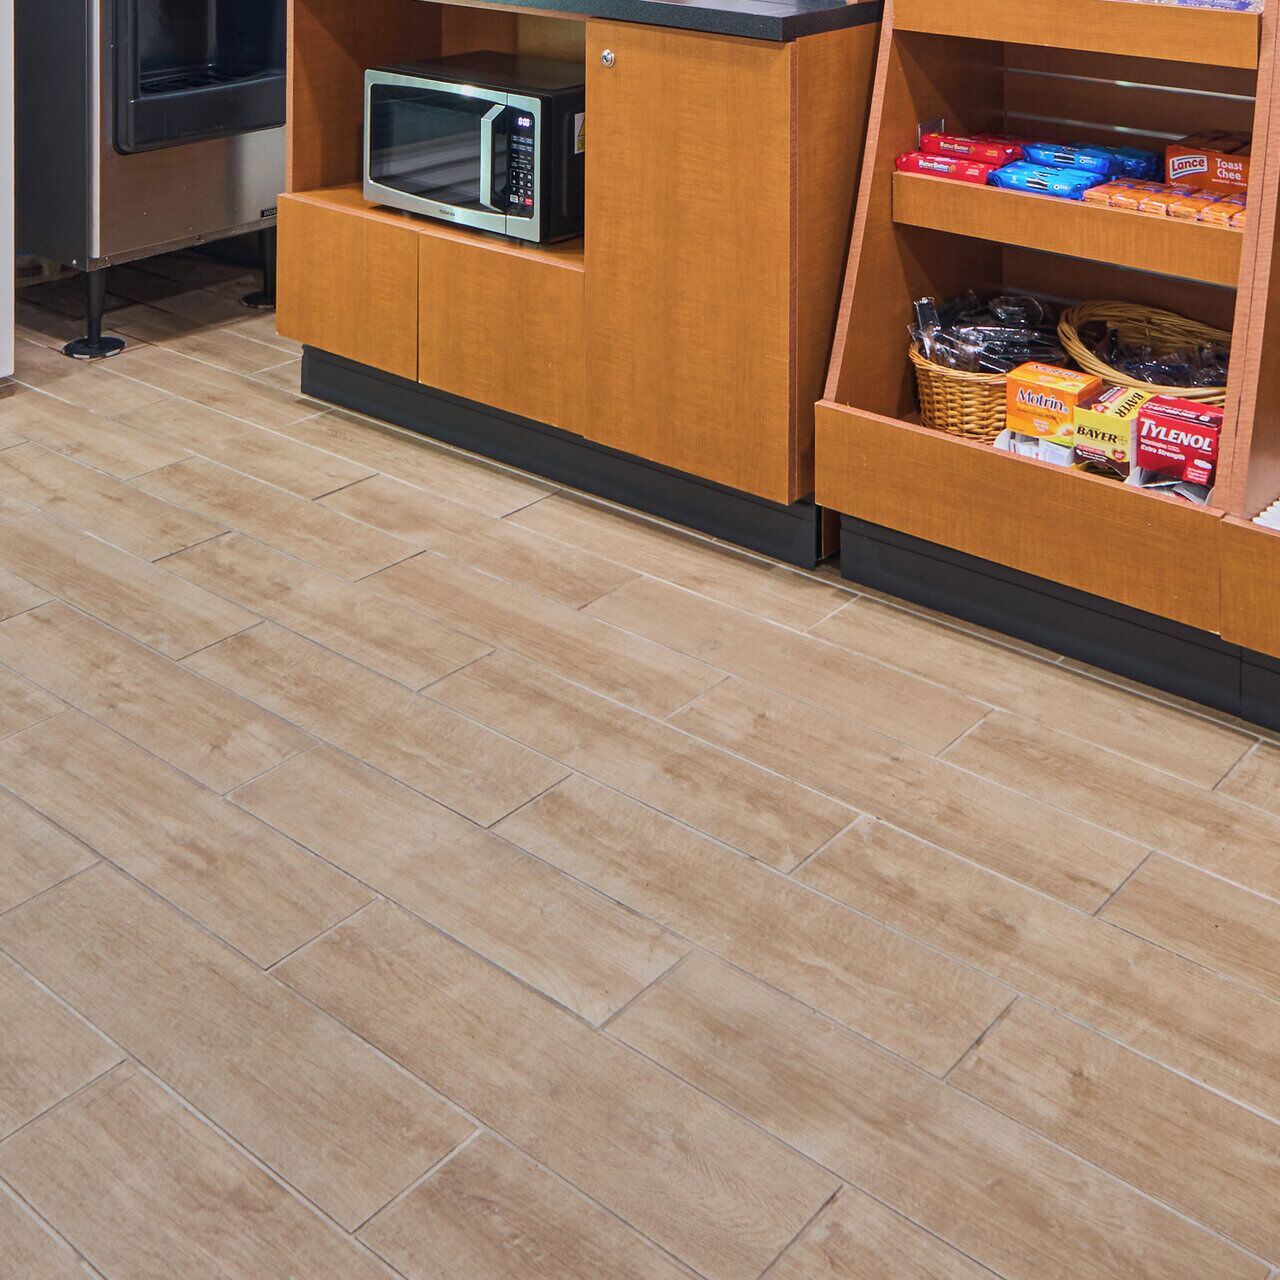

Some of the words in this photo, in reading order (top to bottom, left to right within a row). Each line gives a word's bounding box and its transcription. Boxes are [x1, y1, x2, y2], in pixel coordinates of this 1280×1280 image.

[1172, 159, 1205, 173] Lance
[1215, 158, 1243, 171] Toast
[1216, 168, 1242, 181] Chee
[1017, 387, 1064, 413] Motrin
[1118, 391, 1144, 418] BAYER
[1077, 425, 1117, 444] BAYER
[1140, 419, 1213, 453] TYLENOL
[1140, 444, 1158, 455] Extra
